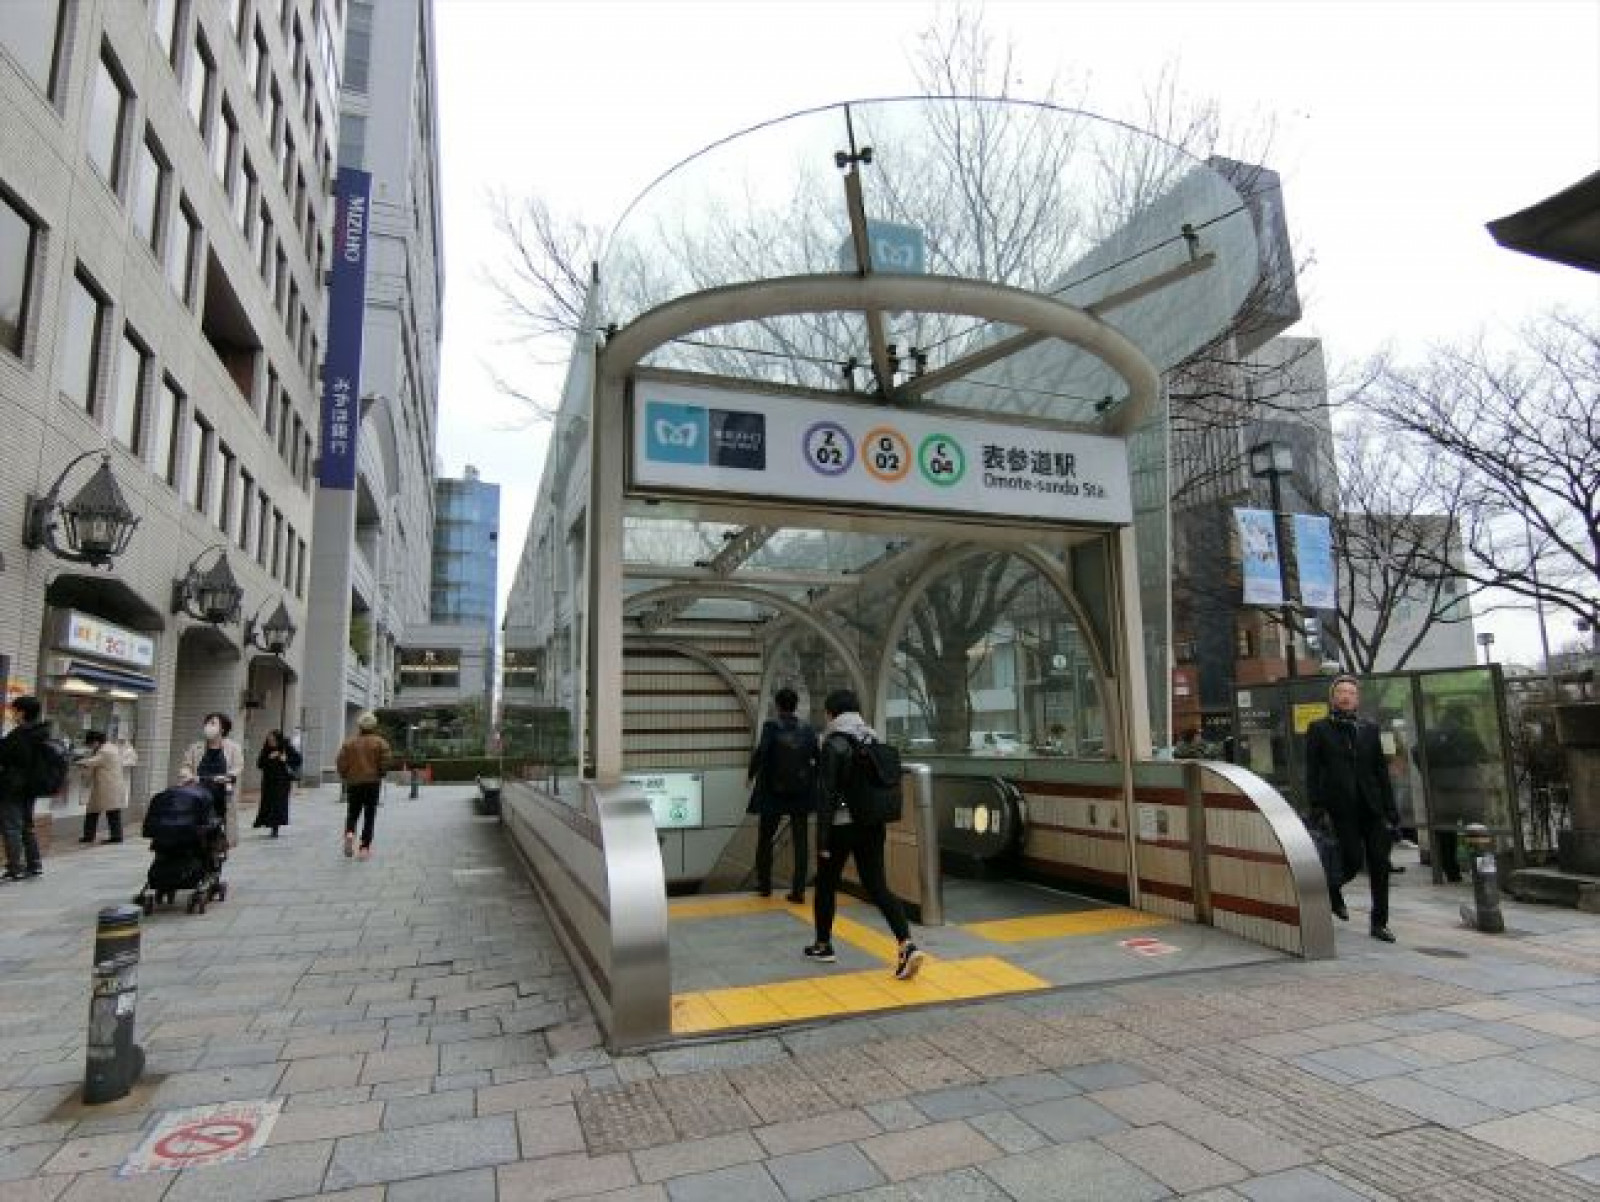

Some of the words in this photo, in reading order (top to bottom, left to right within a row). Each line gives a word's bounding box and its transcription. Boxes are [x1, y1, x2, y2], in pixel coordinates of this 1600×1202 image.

[344, 195, 365, 262] MIZUHO
[823, 430, 835, 446] Z
[817, 447, 842, 466] 02
[876, 452, 899, 469] 02
[931, 457, 954, 474] 04
[983, 443, 1076, 478] 表参道駅
[984, 472, 1079, 496] Omote-sando
